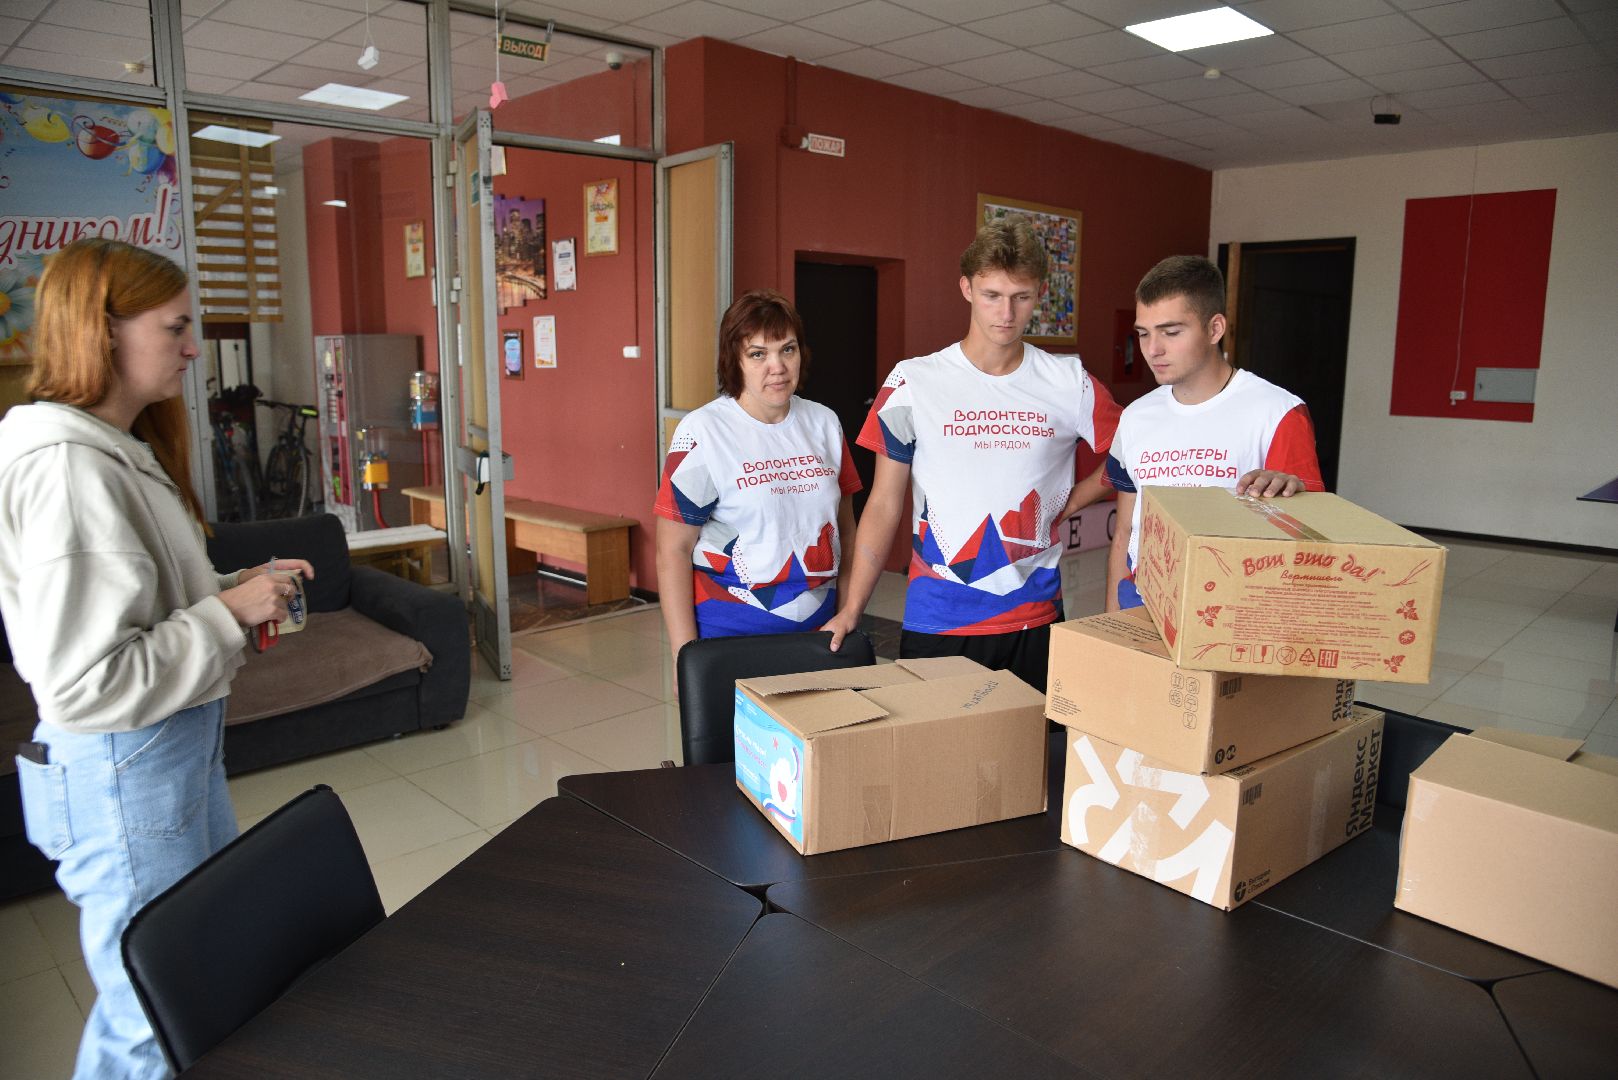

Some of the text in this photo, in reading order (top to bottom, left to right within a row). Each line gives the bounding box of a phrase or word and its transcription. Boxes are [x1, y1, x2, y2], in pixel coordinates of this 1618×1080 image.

[503, 40, 543, 58] ВЫХОД
[954, 409, 1047, 423] ВОЛОНТЕРЫ
[943, 424, 1055, 438] ПОДМОСКОВЬЯ
[974, 440, 1031, 451] МЫ РЯДОМ
[742, 455, 825, 474] ВОЛОНТЕРЫ
[1140, 448, 1228, 464] ВОЛОНТЕРЫ
[736, 467, 836, 490] ПОДМОСКОВЬЯ
[1133, 464, 1237, 480] ПОДМОСКОВЬЯ
[770, 482, 820, 496] МЫ РЯДОМ
[1242, 551, 1380, 583] Вот это да!
[1280, 569, 1344, 583] Вермишель
[1332, 679, 1345, 722] Янд
[1345, 735, 1367, 838] Яндекс
[1359, 729, 1381, 831] Маркет
